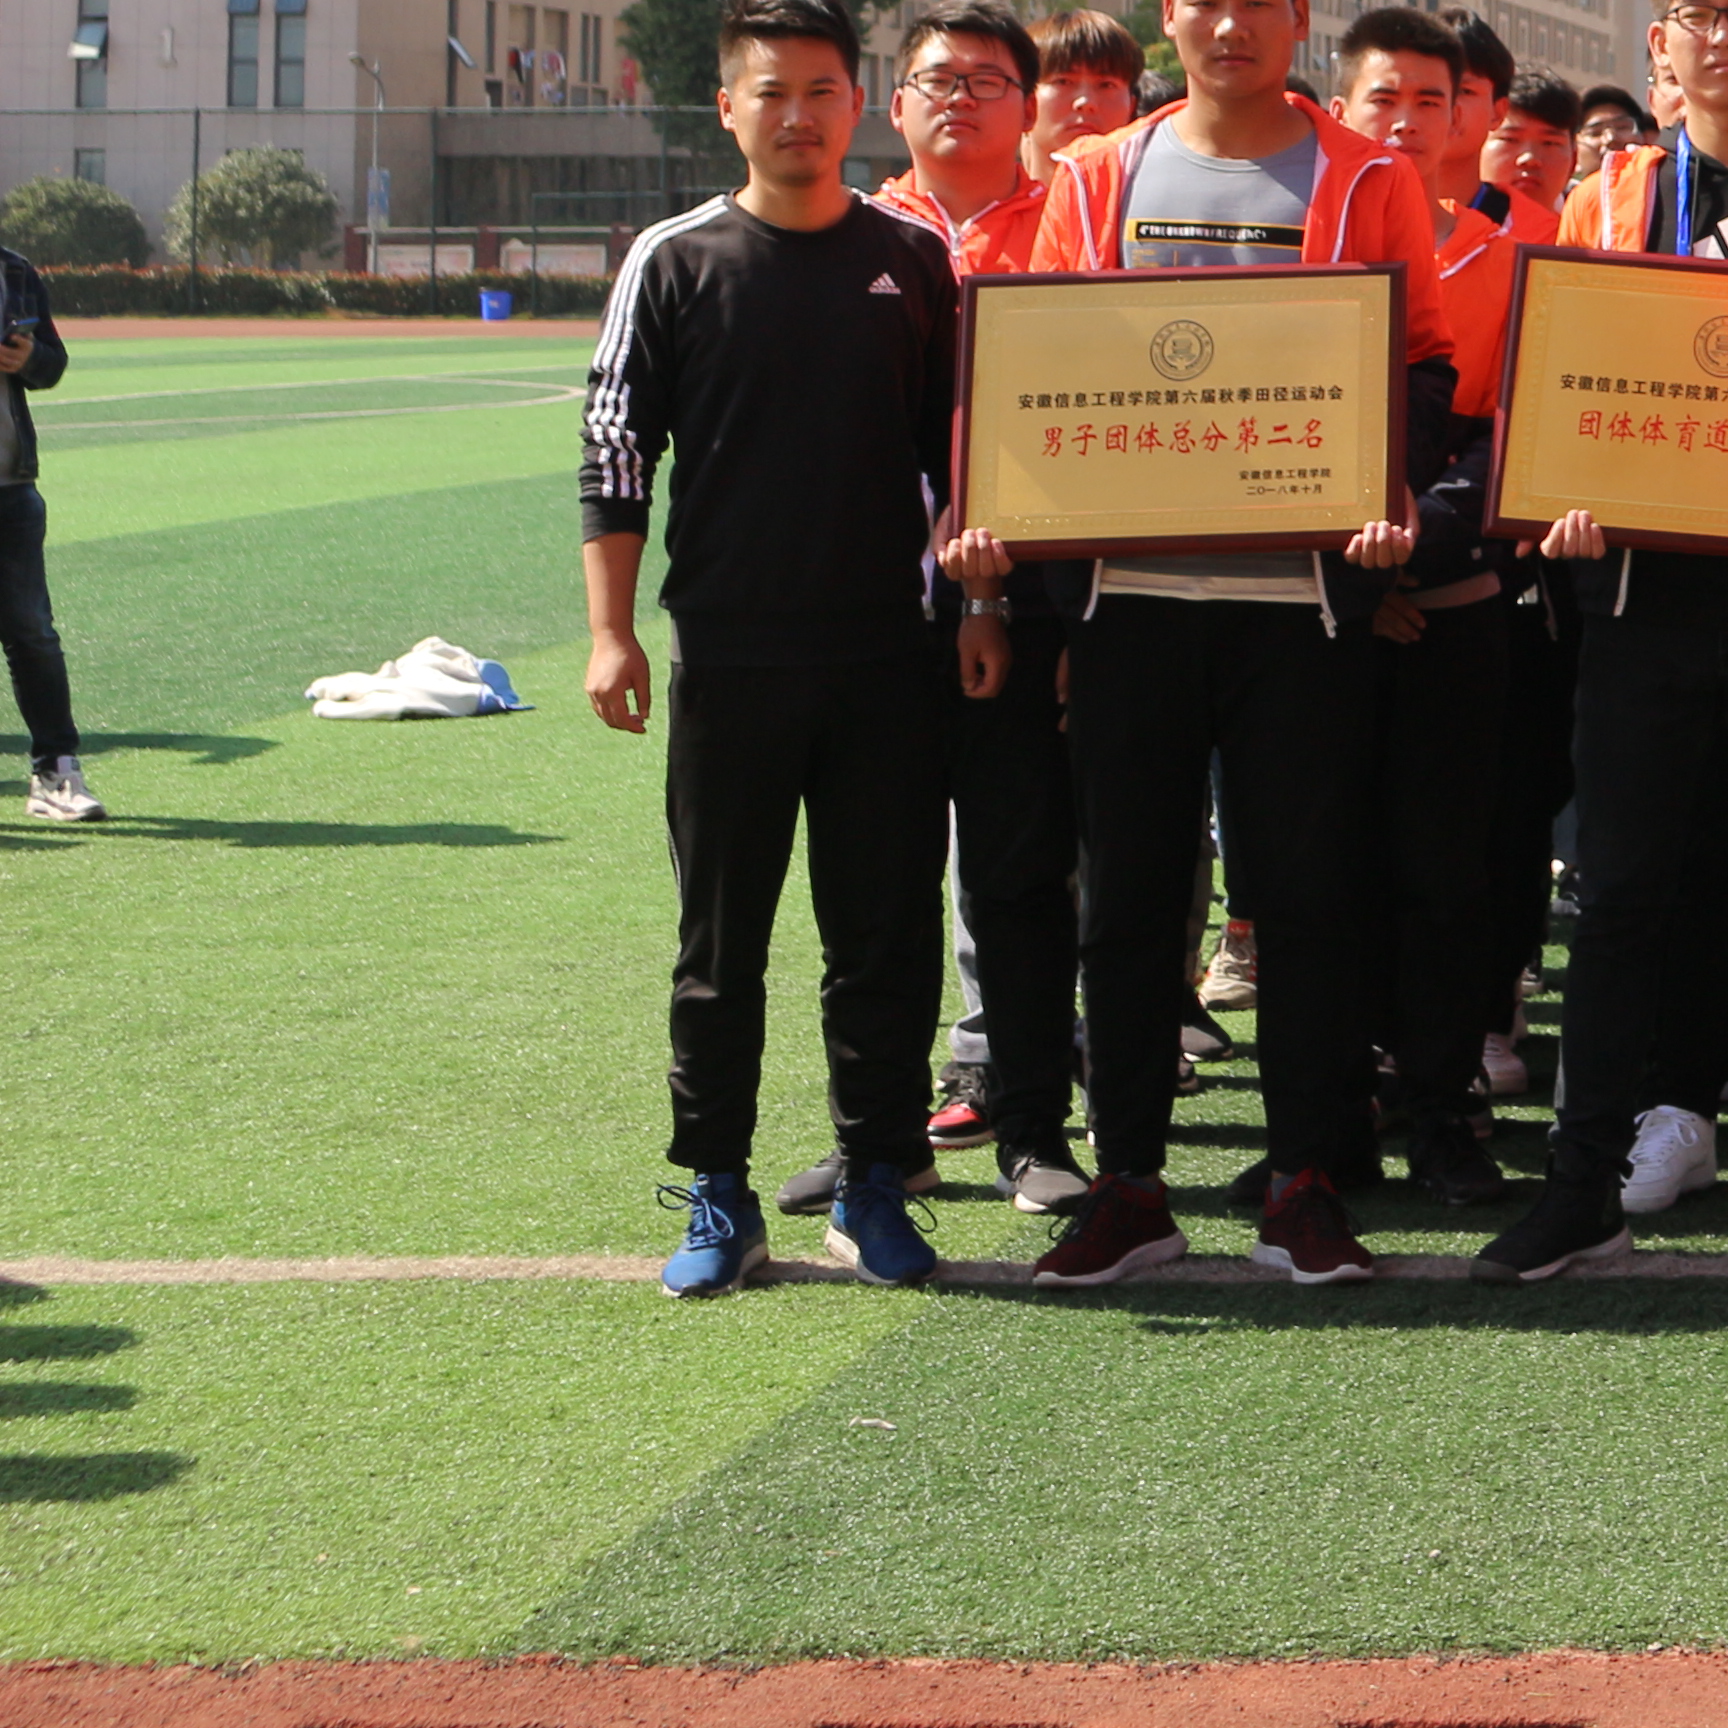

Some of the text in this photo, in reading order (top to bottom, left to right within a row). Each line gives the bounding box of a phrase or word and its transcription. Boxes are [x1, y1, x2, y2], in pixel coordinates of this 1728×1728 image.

[1018, 384, 1344, 410] 安徽信息工程学院第六届秋季田径运动会
[1041, 416, 1325, 458] 男子团体总分第二名
[1238, 466, 1332, 482] 安徽信息工程学院
